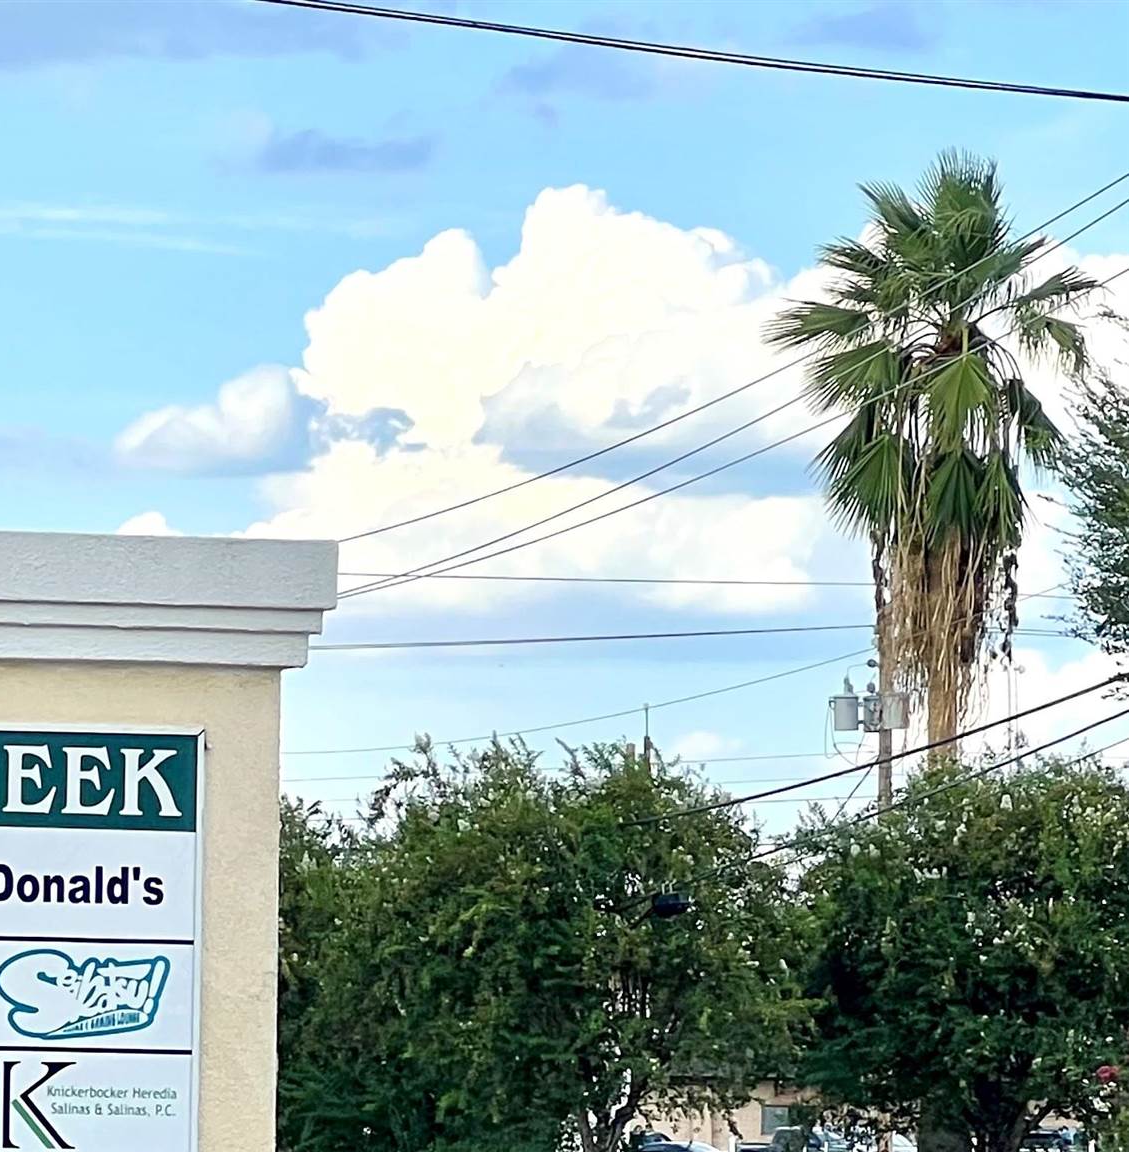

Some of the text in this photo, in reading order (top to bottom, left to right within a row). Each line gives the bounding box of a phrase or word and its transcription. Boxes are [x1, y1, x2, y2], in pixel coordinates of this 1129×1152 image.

[46, 1085, 178, 1100] Knickerbocker Heredia
[50, 1102, 177, 1117] Salinas & Salinas, P.C.
